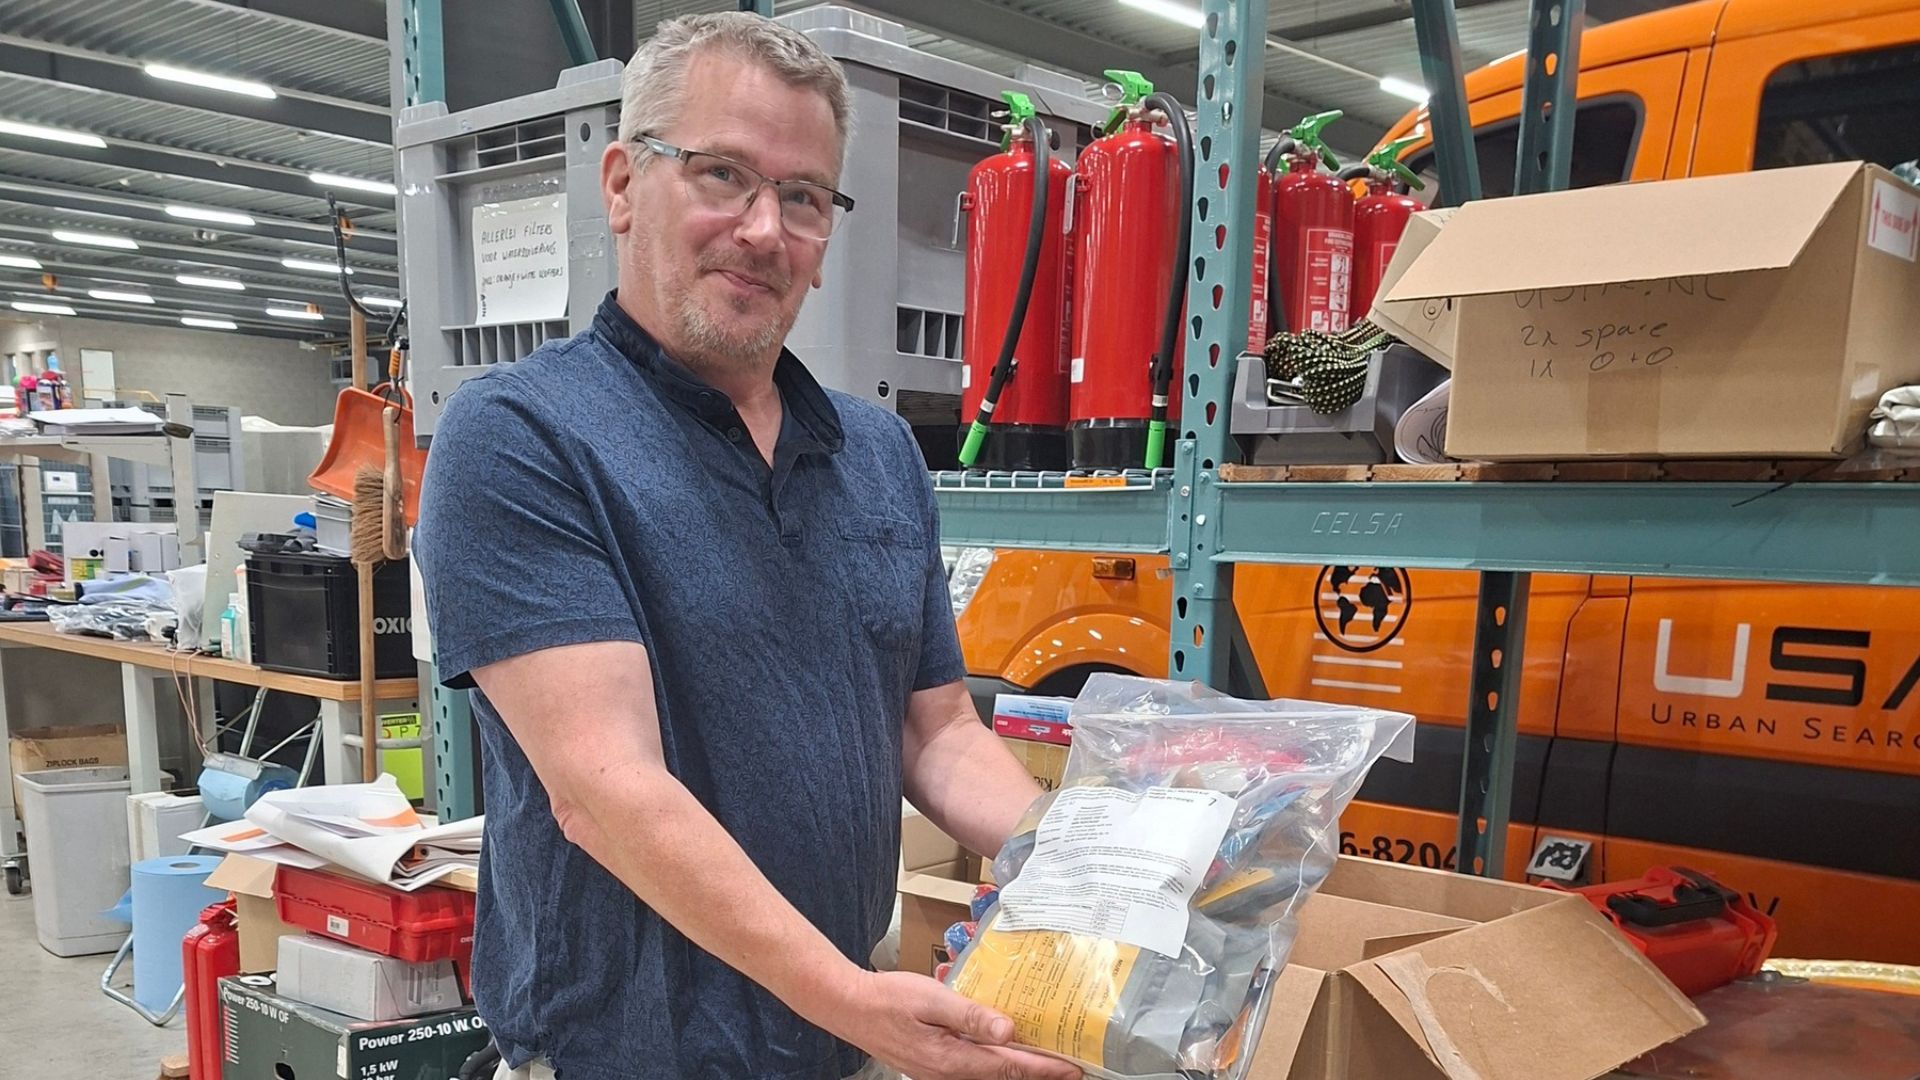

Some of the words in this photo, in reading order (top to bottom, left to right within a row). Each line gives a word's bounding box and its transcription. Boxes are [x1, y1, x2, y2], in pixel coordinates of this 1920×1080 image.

[1312, 511, 1403, 535] CELSA
[79, 757, 99, 765] BAGS
[359, 1033, 404, 1051] Power
[407, 1022, 452, 1042] 250-10
[471, 1016, 488, 1029] O
[360, 1064, 377, 1077] 1,5
[379, 1059, 399, 1073] kW
